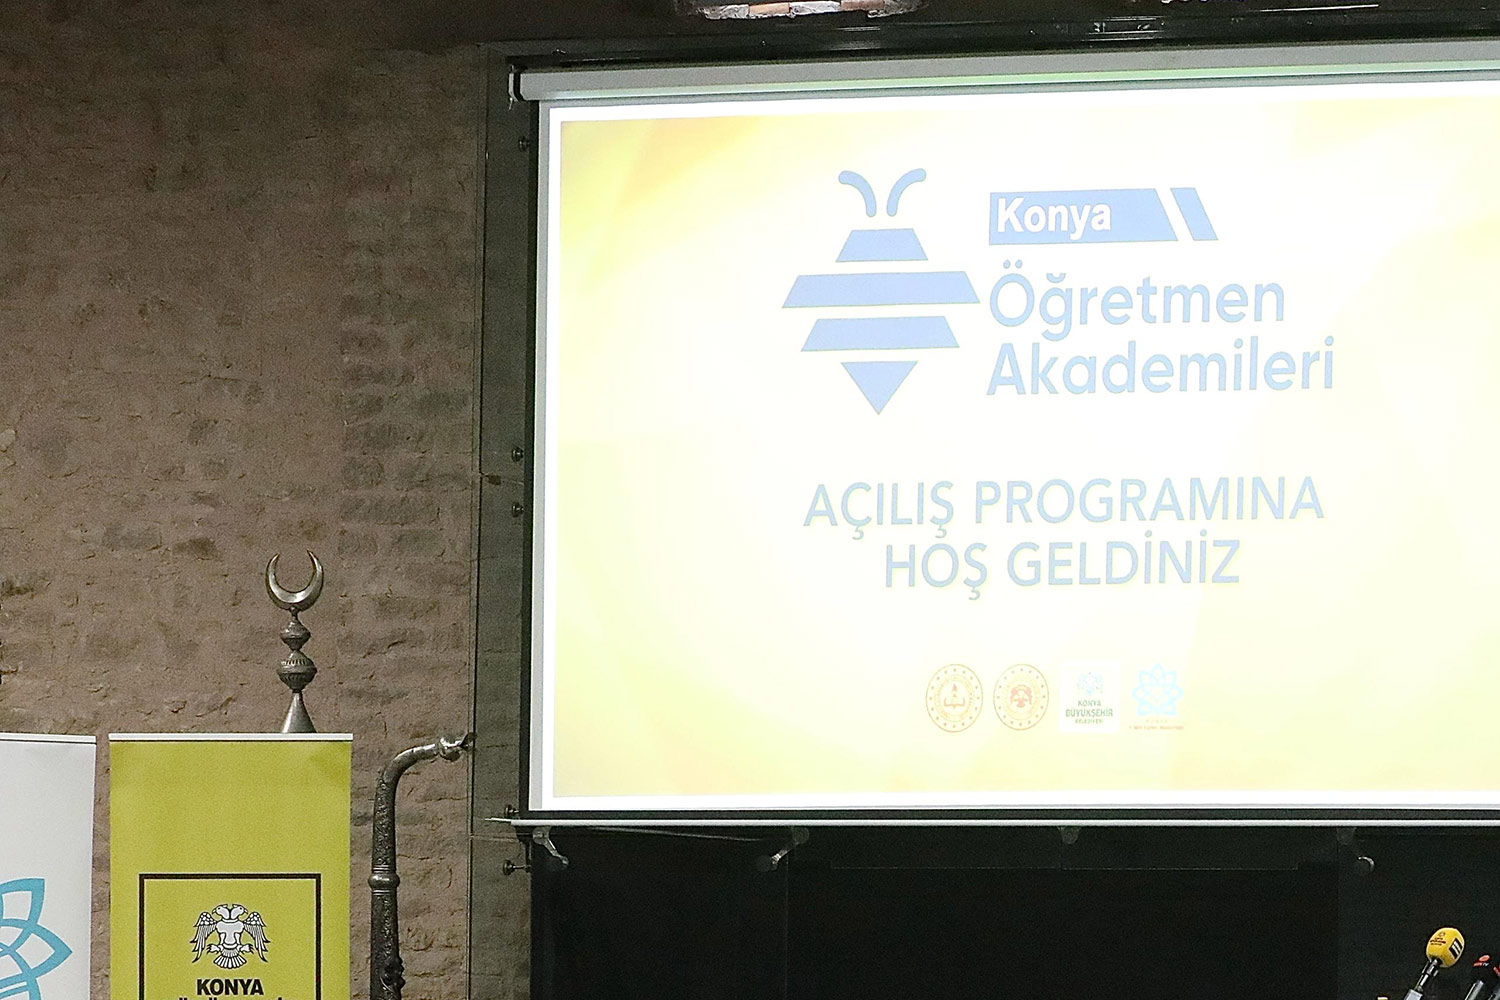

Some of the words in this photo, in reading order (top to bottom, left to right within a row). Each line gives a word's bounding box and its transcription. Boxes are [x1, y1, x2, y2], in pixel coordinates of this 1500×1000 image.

[996, 197, 1112, 240] Konya
[989, 258, 1285, 341] Öğretmen
[987, 335, 1335, 396] Akademileri
[803, 481, 954, 540] AÇILIŞ
[974, 476, 1325, 524] PROGRAMINA
[885, 542, 988, 600] HOŞ
[1007, 529, 1240, 586] GELDİNİZ
[197, 979, 264, 996] KONYA
